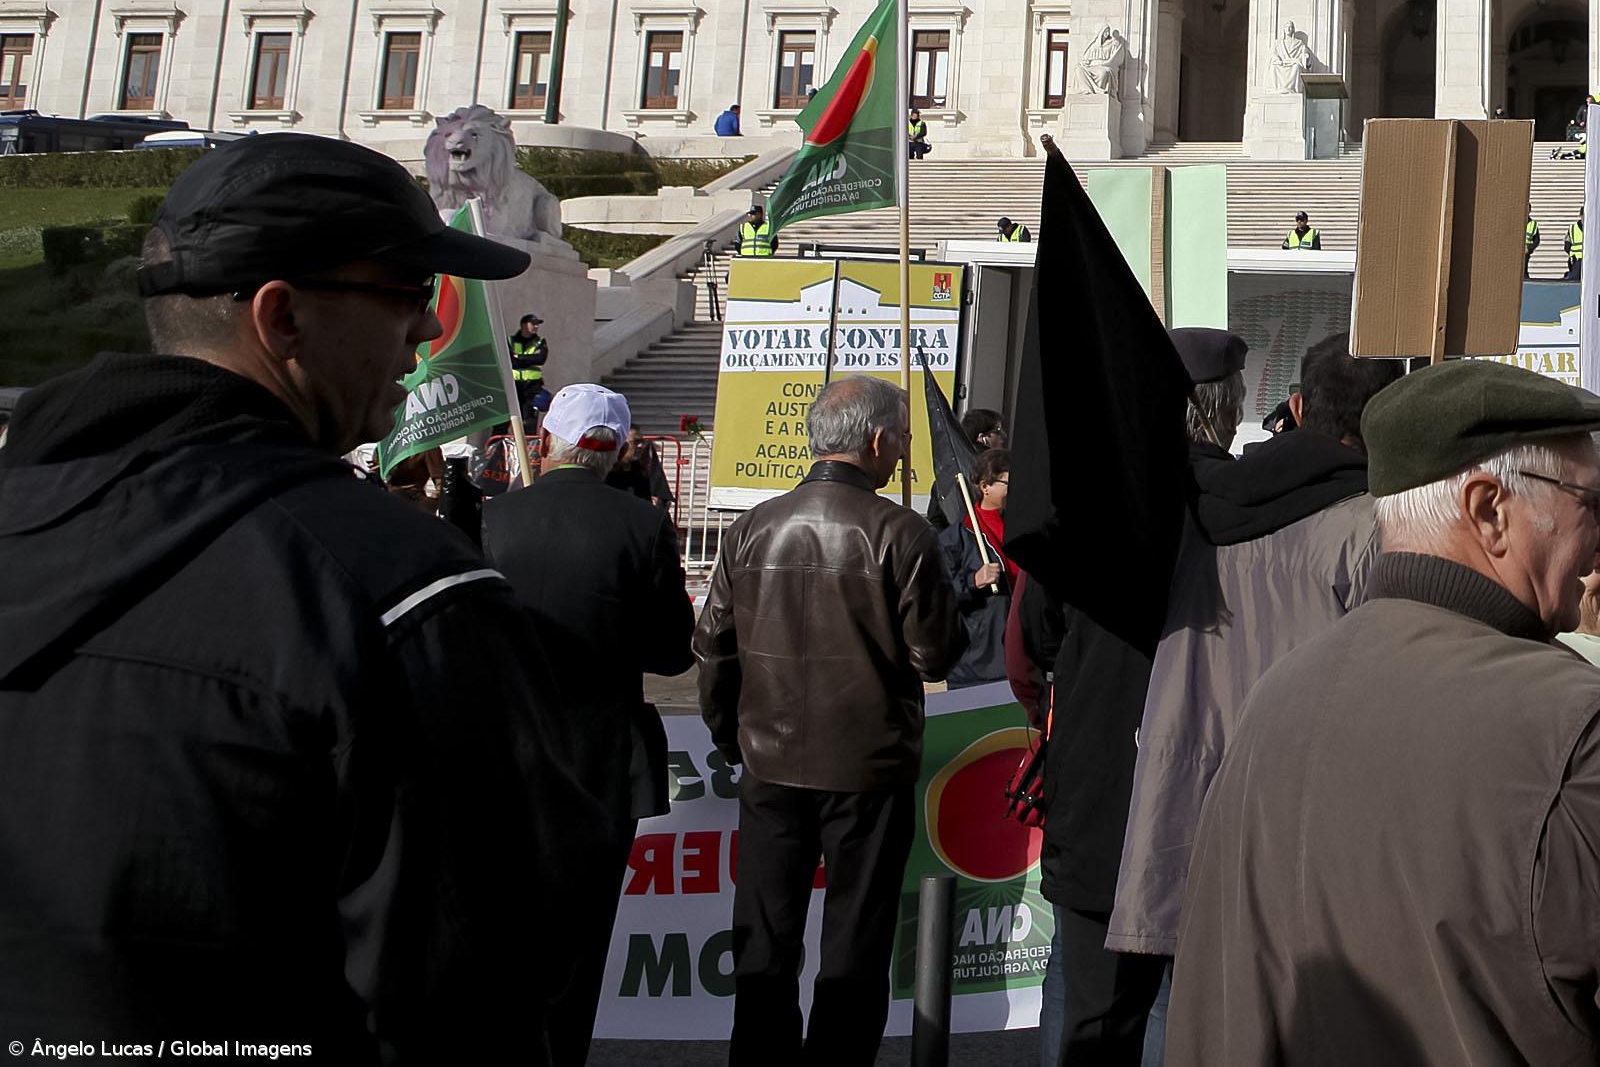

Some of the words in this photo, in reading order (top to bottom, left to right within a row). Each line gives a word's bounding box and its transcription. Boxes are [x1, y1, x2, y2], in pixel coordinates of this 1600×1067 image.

[728, 328, 812, 350] VOTAR
[726, 353, 839, 372] ORÇAMENTO
[844, 353, 871, 367] DO
[875, 352, 949, 366] ESADO
[766, 420, 774, 435] E
[778, 421, 789, 436] A
[756, 444, 812, 460] ACABA
[736, 460, 805, 479] POLÍTICA
